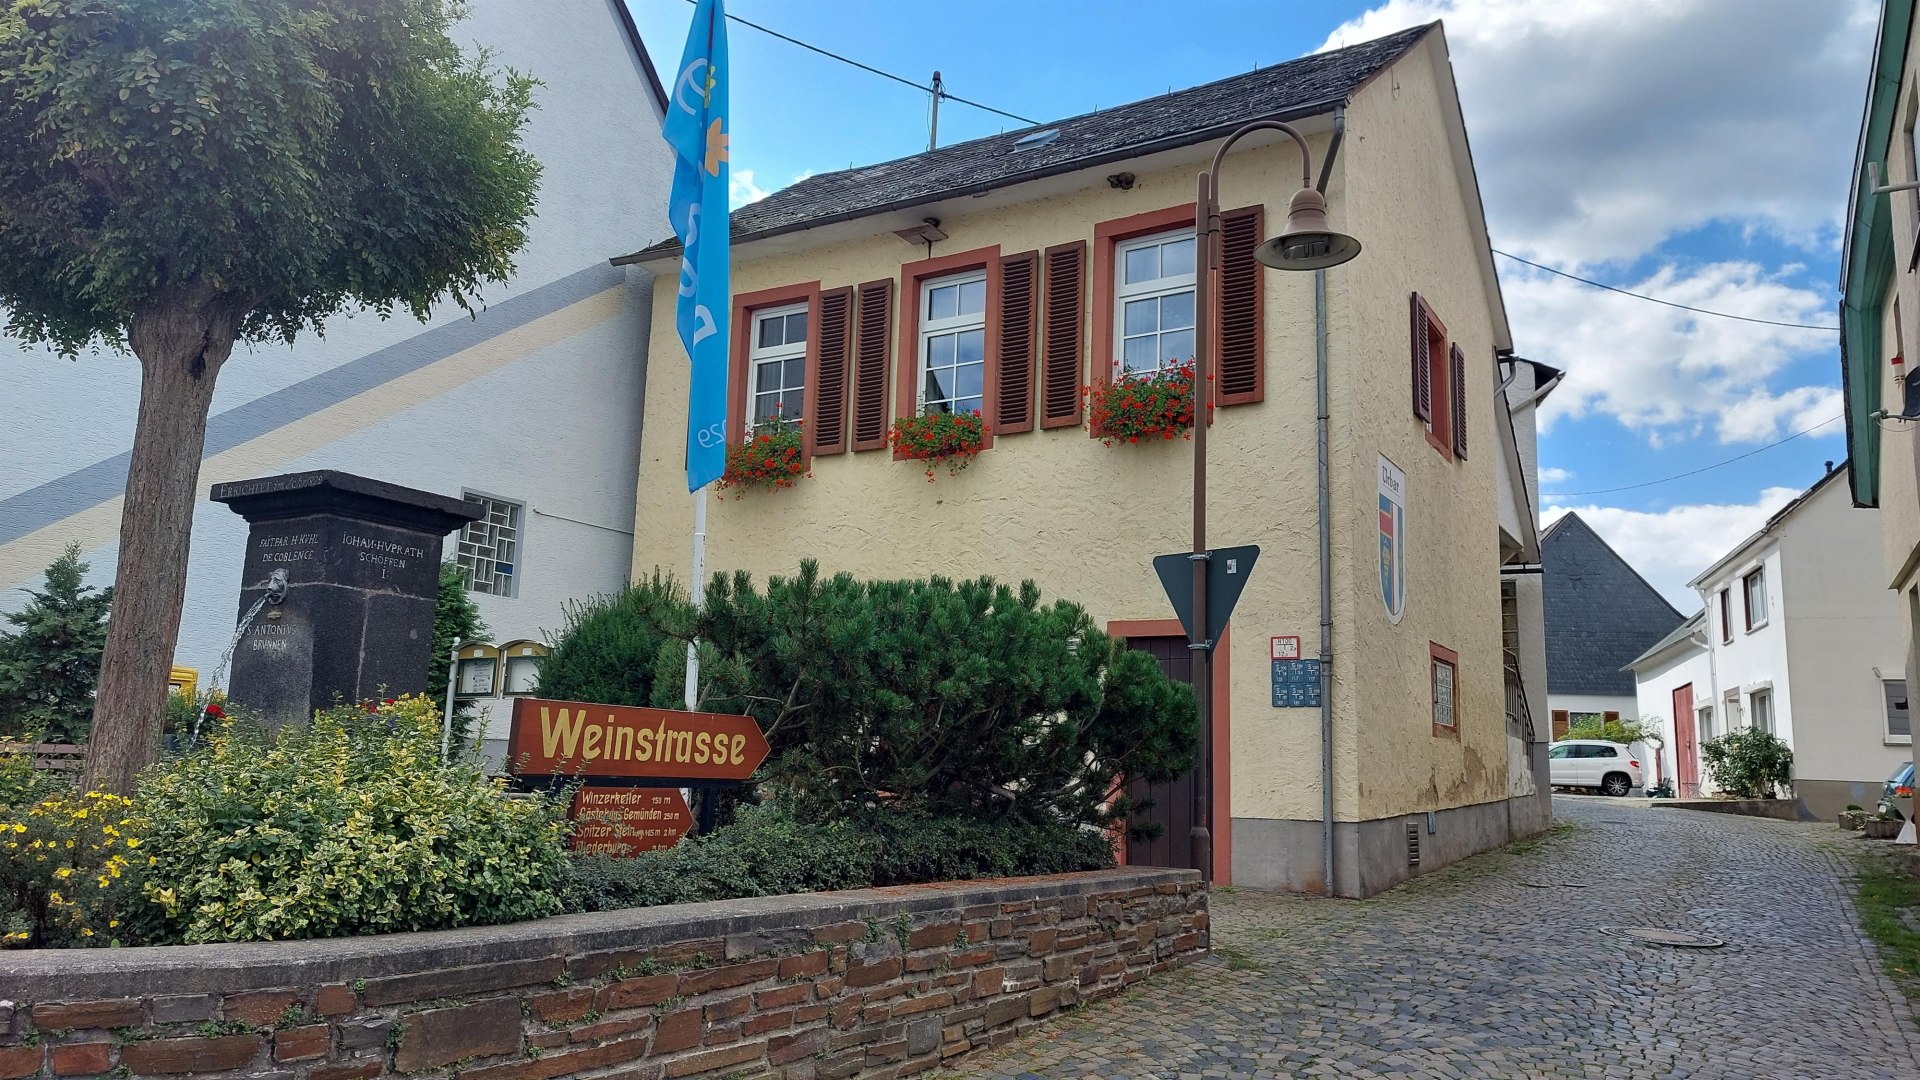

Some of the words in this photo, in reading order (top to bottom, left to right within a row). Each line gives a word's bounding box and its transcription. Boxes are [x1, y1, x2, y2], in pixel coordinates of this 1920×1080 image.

[262, 553, 273, 562] DE
[273, 550, 314, 562] COBLENCE
[540, 706, 746, 765] Weinstrasse
[582, 791, 641, 805] Winzerkeller
[623, 807, 662, 820] Gemünden
[663, 812, 674, 820] 250
[577, 824, 612, 839] Spitzer
[663, 829, 668, 837] 2
[667, 827, 677, 837] km
